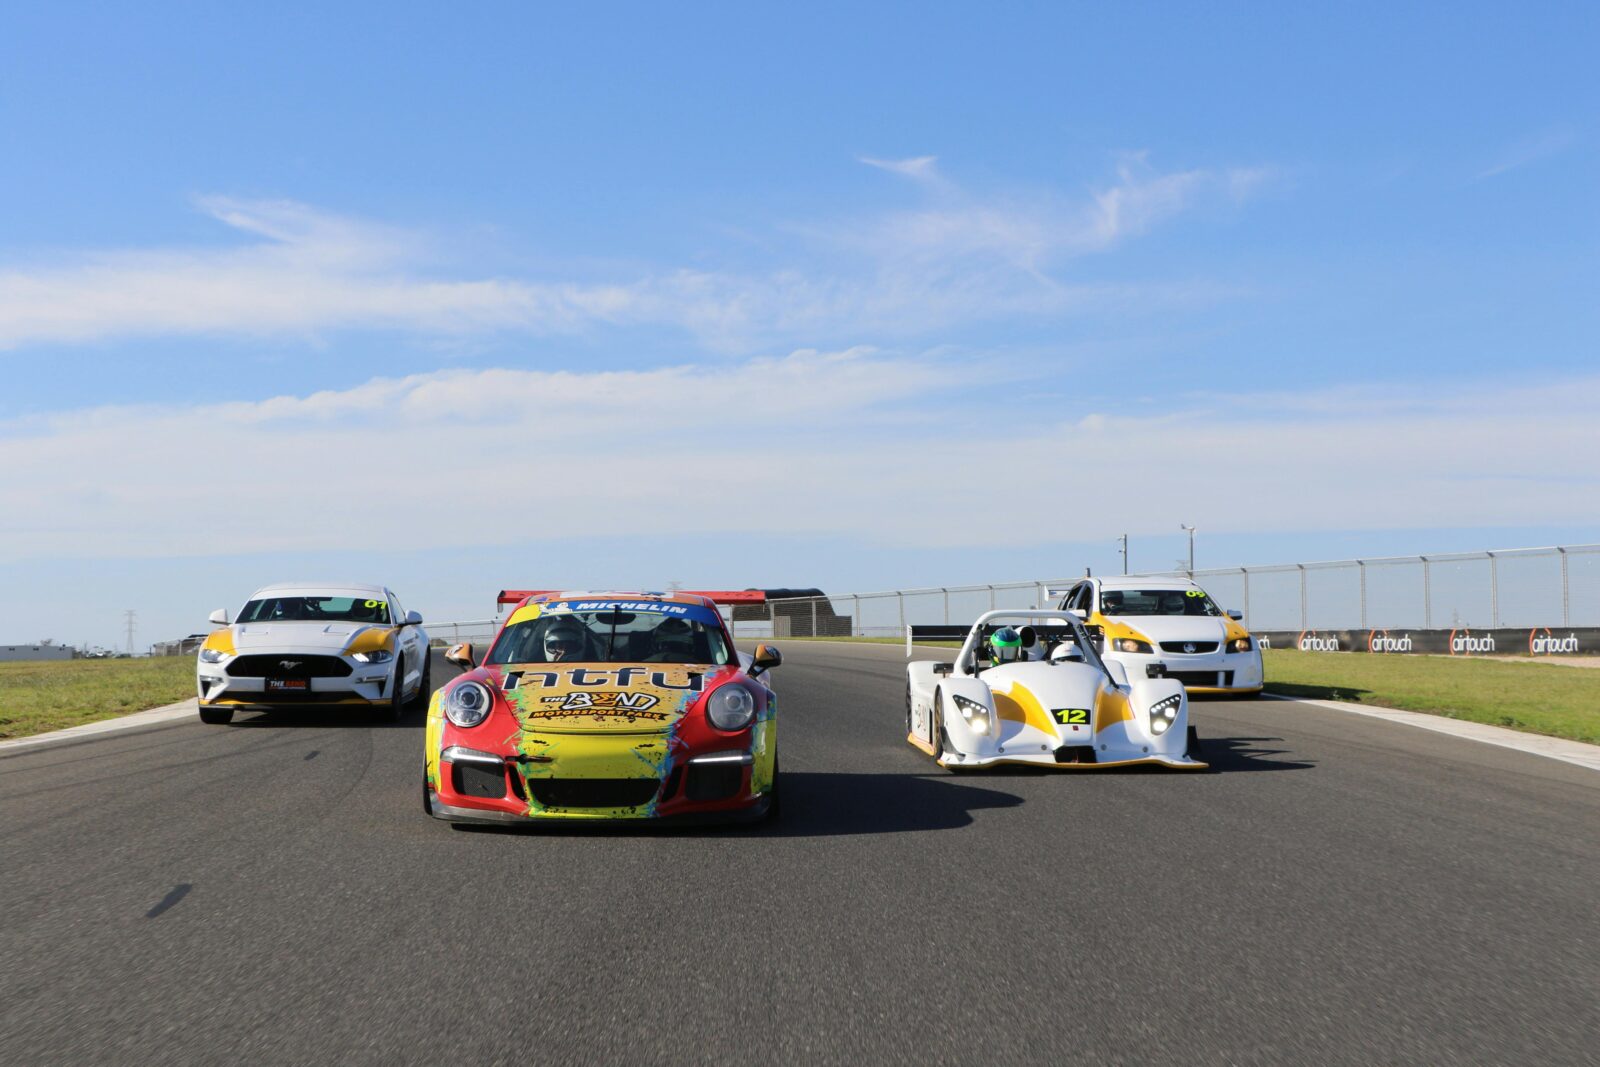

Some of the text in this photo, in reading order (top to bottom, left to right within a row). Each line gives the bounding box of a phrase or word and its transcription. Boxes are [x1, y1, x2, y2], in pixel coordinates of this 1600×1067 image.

[1186, 590, 1206, 598] 09
[364, 600, 387, 609] 01
[576, 602, 688, 614] MICHELIN
[1301, 634, 1339, 651] airtouch
[1372, 634, 1412, 651] airtouch
[1452, 633, 1495, 651] airtouch
[1532, 633, 1578, 652] airtouch
[502, 667, 704, 691] ntfu
[532, 710, 664, 720] MOTORSPORT PARK
[1056, 710, 1086, 723] 12
